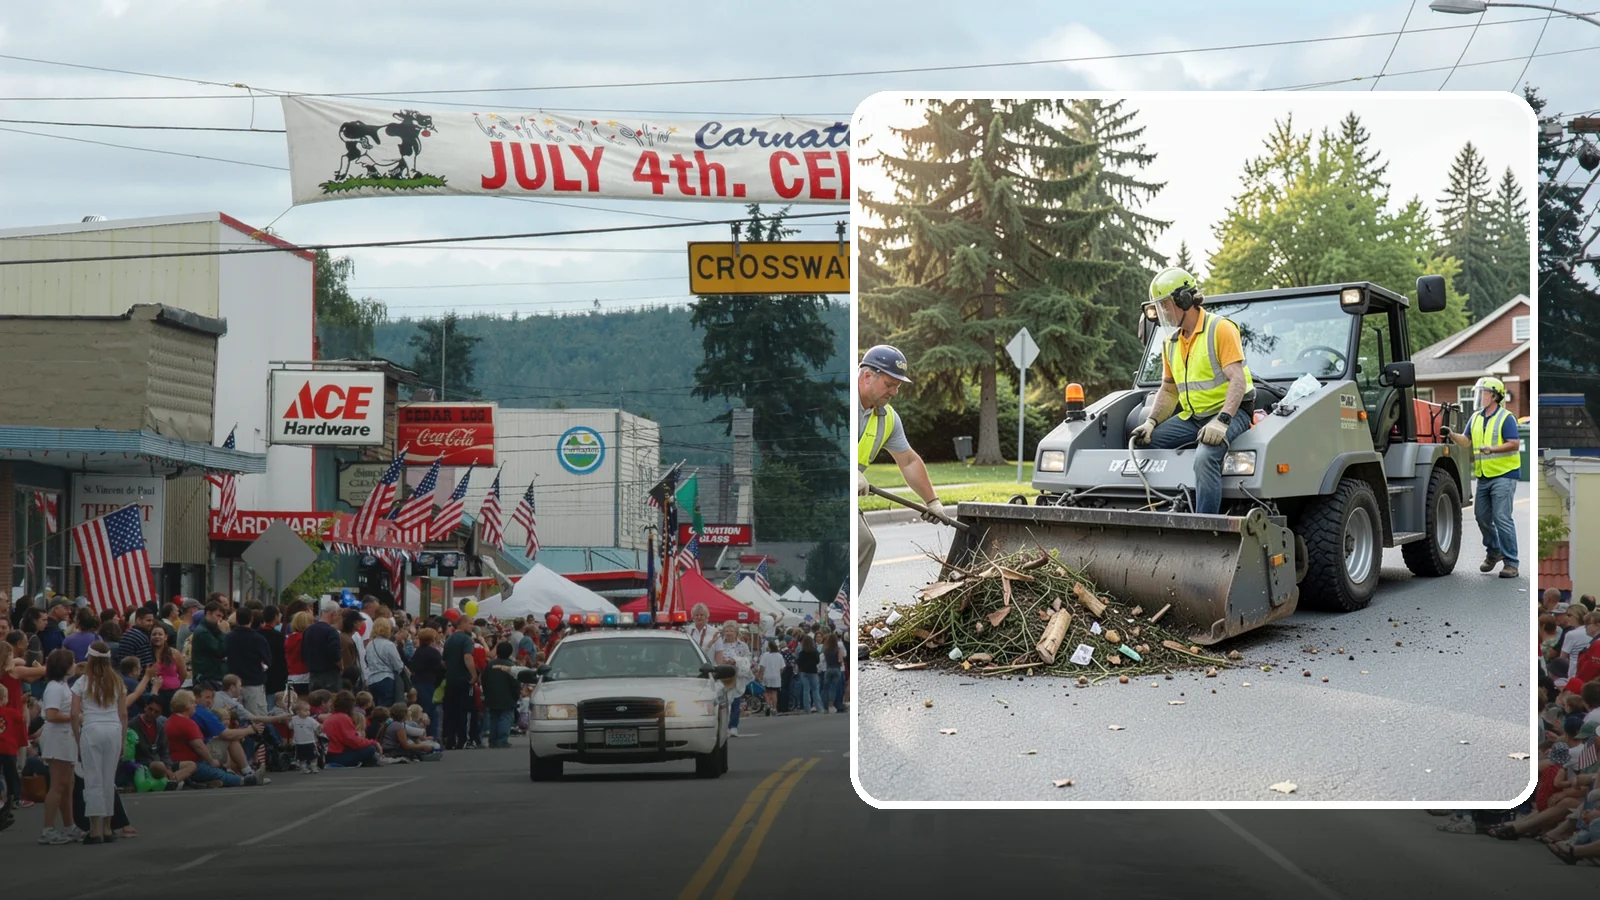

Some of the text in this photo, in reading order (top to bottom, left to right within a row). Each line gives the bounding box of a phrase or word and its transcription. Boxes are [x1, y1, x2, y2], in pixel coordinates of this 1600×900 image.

[695, 121, 850, 150] Carnat
[481, 141, 604, 192] JULY
[632, 150, 746, 197] 4th.
[697, 254, 850, 280] CROSSWA
[283, 380, 373, 420] ACE
[406, 409, 485, 423] CEDAR LOG
[283, 421, 370, 436] Hardware
[416, 428, 476, 447] Coca-Cola
[353, 467, 385, 481] Simpl
[95, 485, 124, 495] Vincent
[126, 486, 135, 495] de
[137, 486, 155, 495] Paul
[688, 526, 741, 535] CRNATION
[699, 535, 730, 543] GLASS
